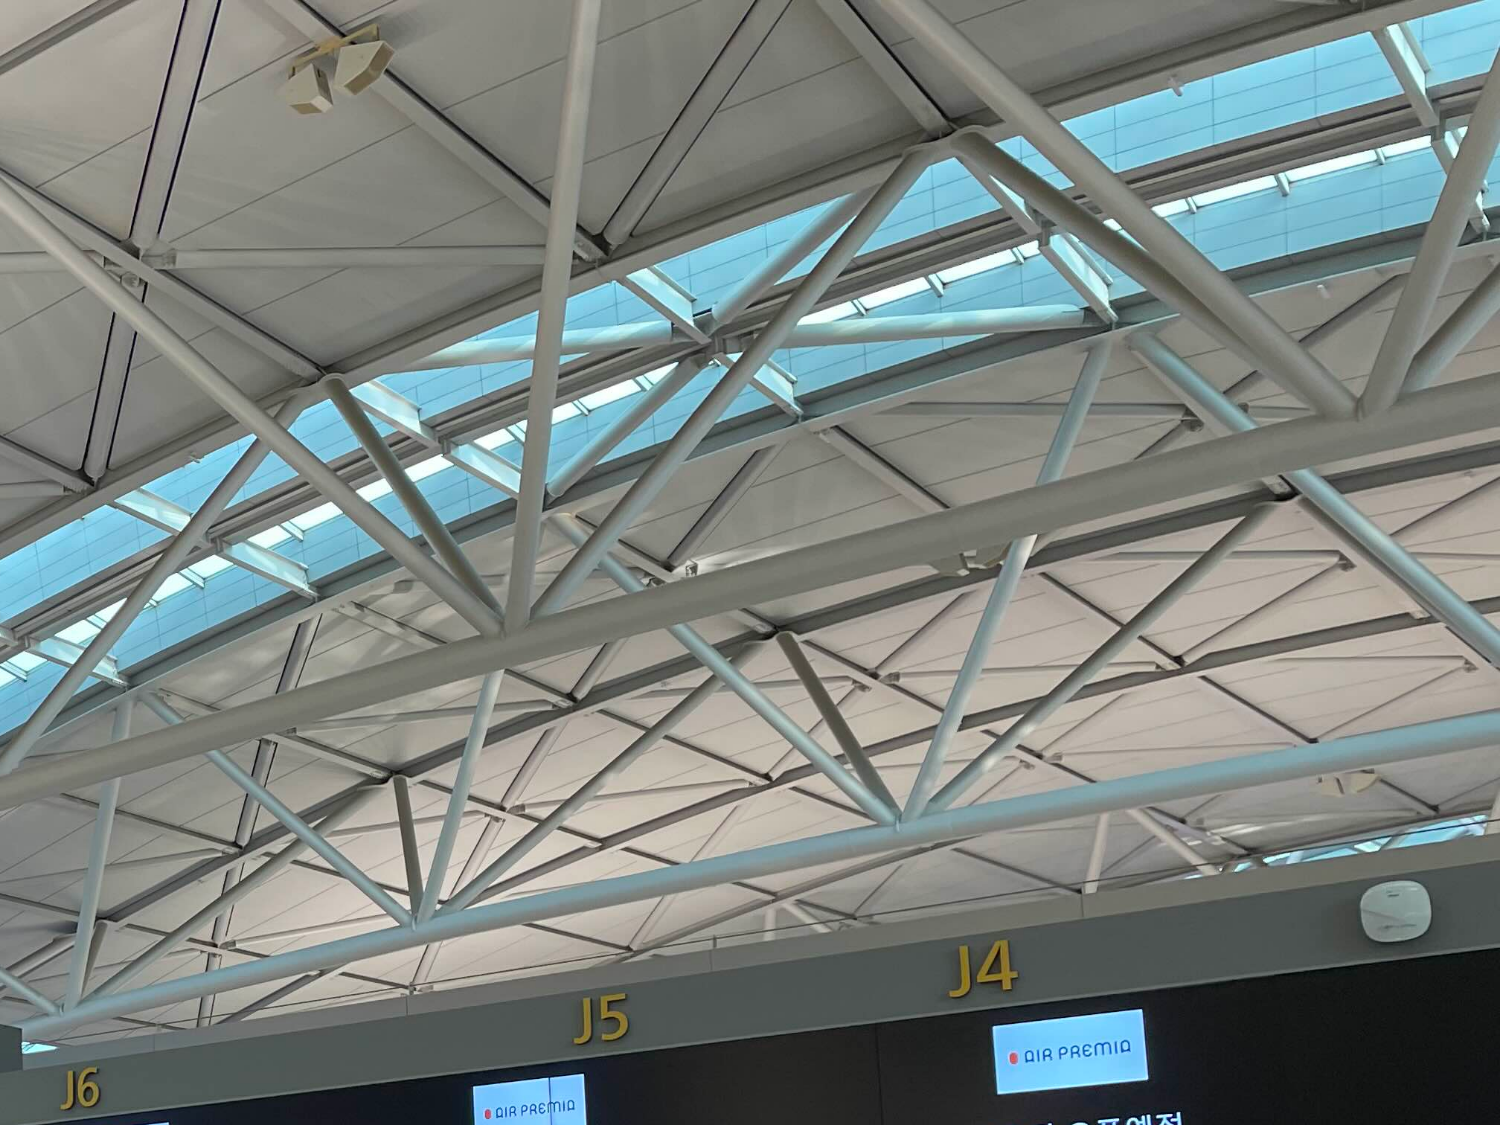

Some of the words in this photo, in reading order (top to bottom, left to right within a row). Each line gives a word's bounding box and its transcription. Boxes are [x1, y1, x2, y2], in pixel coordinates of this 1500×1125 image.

[948, 939, 1019, 998] J4
[573, 992, 630, 1045] J5
[1024, 1048, 1053, 1063] AIR
[1058, 1039, 1132, 1060] PREMIA
[60, 1066, 100, 1111] J6
[495, 1106, 518, 1119] AIR
[520, 1099, 576, 1117] PREMIA
